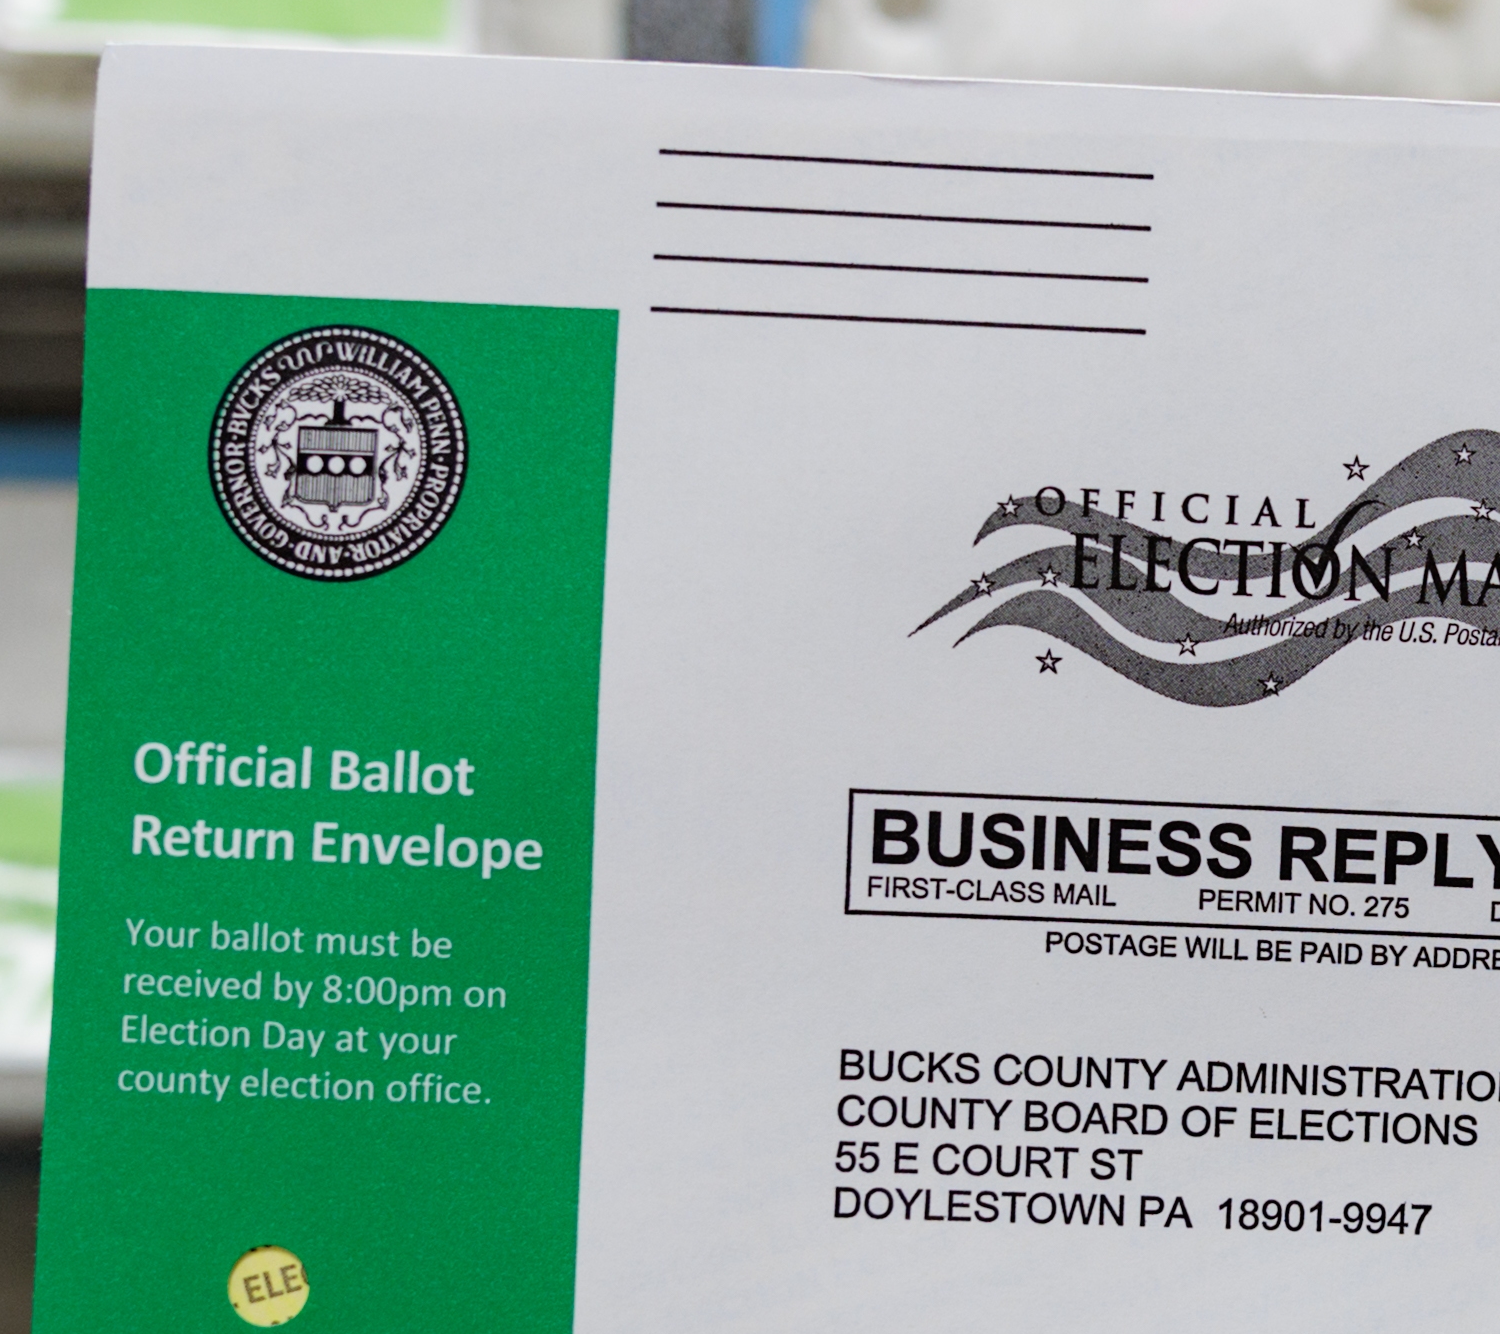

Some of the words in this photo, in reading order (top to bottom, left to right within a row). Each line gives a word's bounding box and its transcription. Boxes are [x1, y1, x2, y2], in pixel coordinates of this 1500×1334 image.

[336, 340, 430, 397] WILLIAM
[419, 395, 451, 455] PENN
[223, 441, 291, 549] GOVERNOR
[349, 463, 451, 563] PROPRIATOR
[1034, 486, 1316, 529] OFFICIAL
[293, 540, 346, 565] AND
[1069, 531, 1397, 603] ELECTION
[1223, 612, 1327, 639] Authorized
[1333, 619, 1358, 642] by
[1362, 620, 1394, 642] the
[1399, 621, 1438, 645] U.S.
[1443, 623, 1500, 647] Postal
[134, 740, 313, 790] Official
[330, 749, 475, 797] Ballot
[131, 814, 295, 861] Return
[311, 821, 543, 880] Envelope
[871, 808, 1253, 880] BUSINESS
[867, 875, 1045, 904] FIRST-CLASS
[1053, 882, 1117, 907] MAIL
[1198, 888, 1303, 914] PERMIT
[1308, 892, 1356, 917] NO.
[1363, 895, 1410, 919] 275
[125, 917, 201, 949] Your
[211, 920, 305, 954] ballot
[315, 930, 400, 958] must
[411, 927, 453, 959] be
[1045, 930, 1178, 958] POSTAGE
[1184, 935, 1249, 961] WILL
[1256, 939, 1293, 963] BE
[1300, 941, 1363, 965] PAID
[1370, 943, 1408, 967] BY
[123, 968, 263, 1000] received
[273, 971, 314, 1009] by
[322, 974, 452, 1013] 8:00pm
[463, 986, 507, 1009] on
[121, 1013, 251, 1048] Election
[262, 1020, 326, 1058] Day
[335, 1026, 369, 1053] at
[379, 1032, 458, 1061] your
[117, 1068, 231, 1102] county
[239, 1067, 375, 1101] election
[385, 1072, 491, 1105] office.
[839, 1048, 981, 1085] BUCKS
[993, 1053, 1168, 1091] COUNTY
[837, 1094, 1013, 1132] COUNTY
[1024, 1099, 1169, 1136] BOARD
[1181, 1104, 1238, 1138] OF
[1249, 1107, 1478, 1147] ELECTIONS
[834, 1140, 880, 1174] 55
[893, 1141, 919, 1175] E
[932, 1142, 1080, 1179] COURT
[1090, 1147, 1144, 1182] ST
[833, 1186, 1125, 1227] DOYLESTOWN
[1139, 1195, 1194, 1229] PA
[1218, 1197, 1433, 1236] 18901-9947
